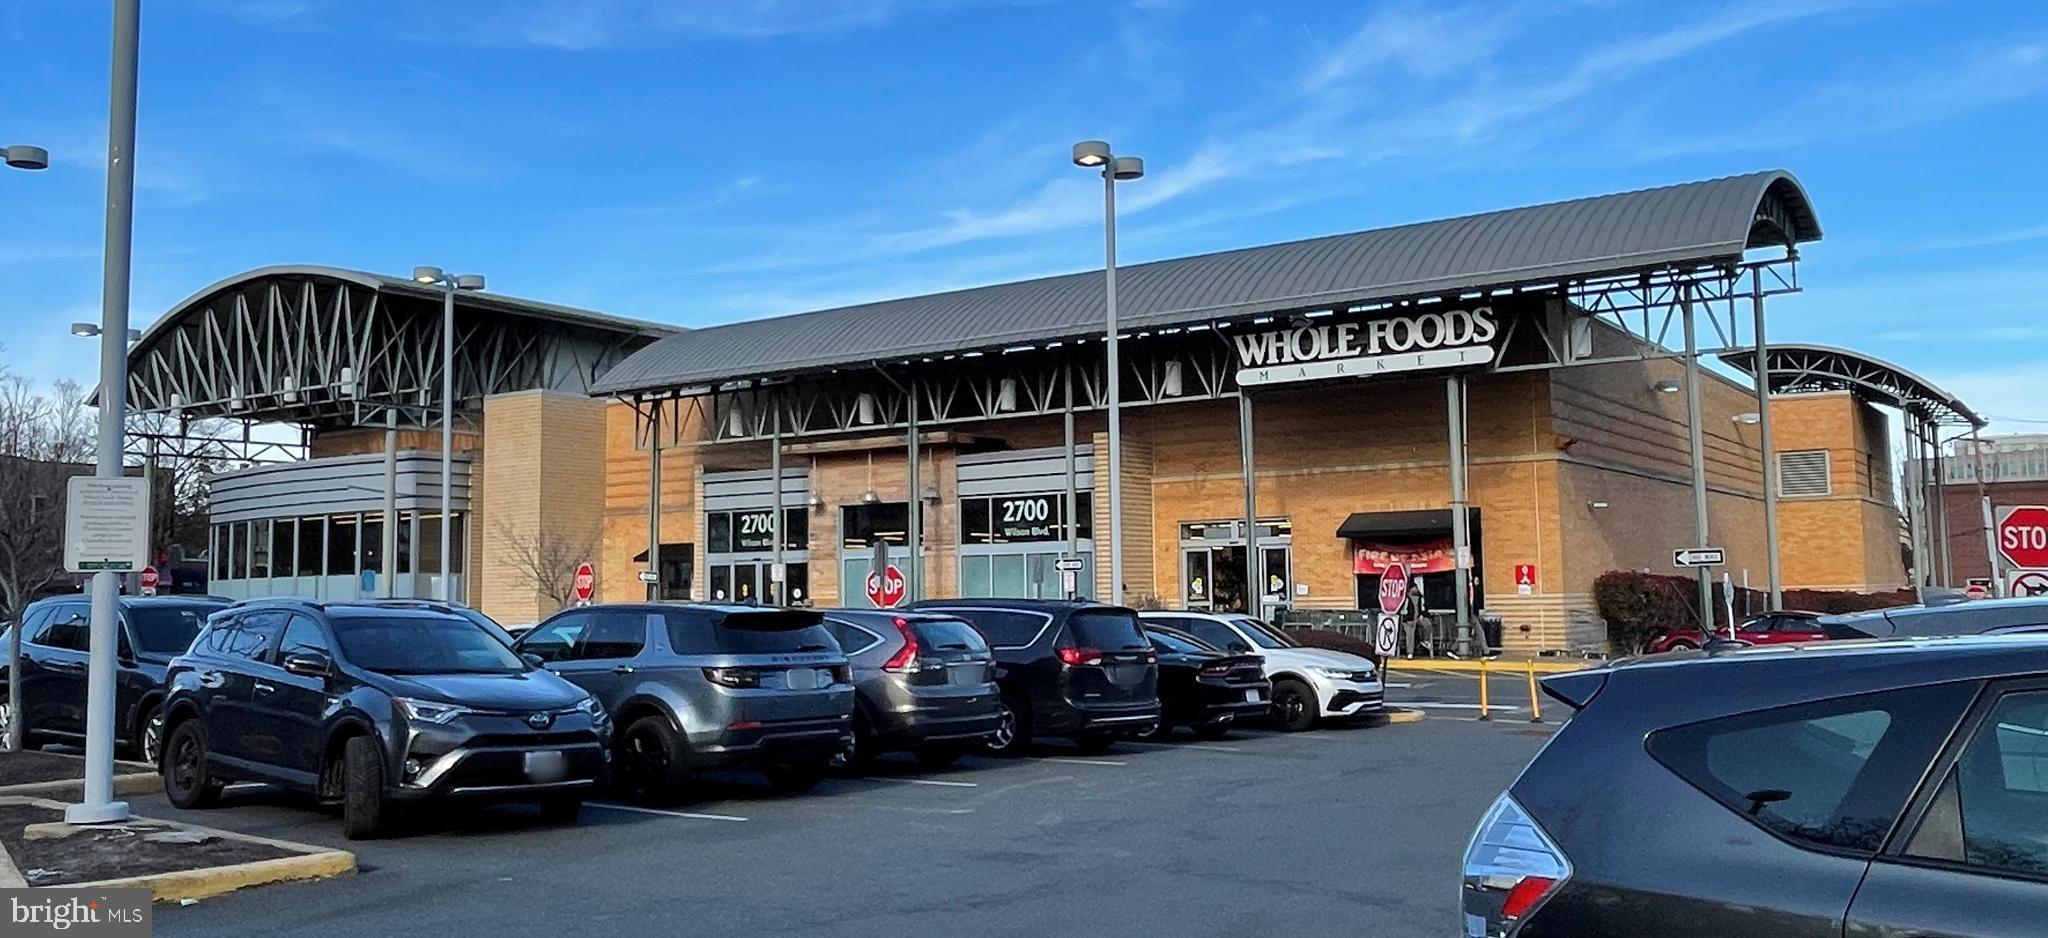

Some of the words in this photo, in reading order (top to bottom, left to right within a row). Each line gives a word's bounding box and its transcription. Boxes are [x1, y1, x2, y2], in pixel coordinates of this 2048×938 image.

[1233, 322, 1361, 367] WHOLE
[1367, 306, 1496, 355] FOODS
[1258, 351, 1467, 382] MARKET
[1002, 498, 1049, 523] 2700
[1004, 527, 1030, 537] Wilson
[2003, 525, 2048, 550] STO
[869, 578, 903, 595] SOP
[1381, 578, 1405, 598] STOP
